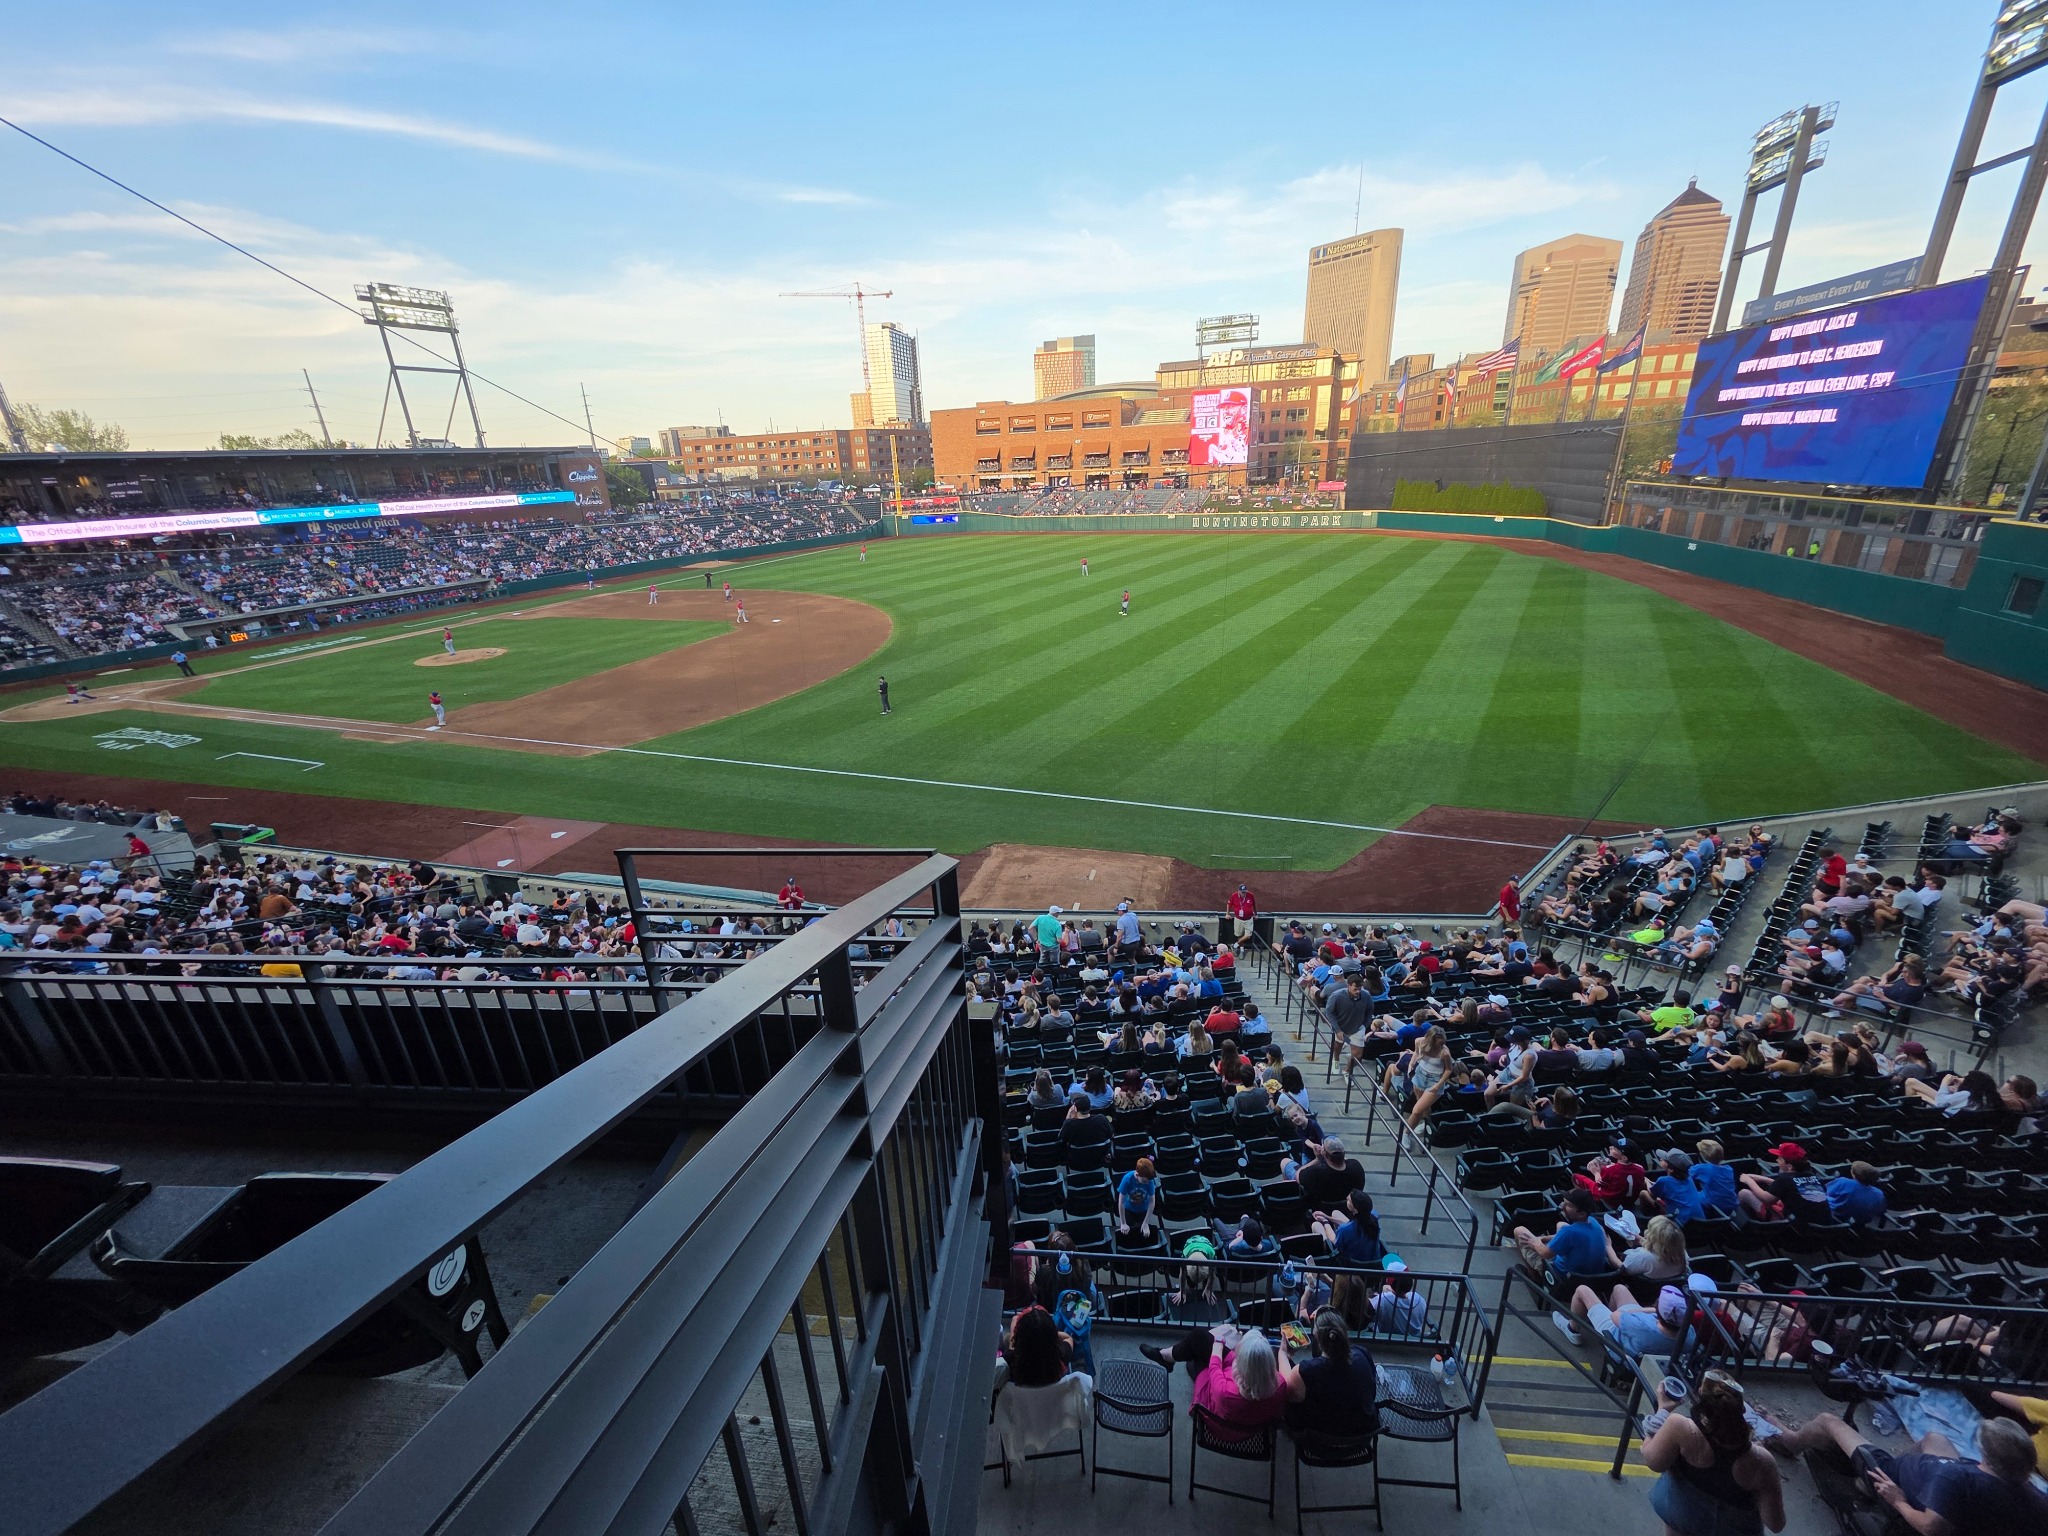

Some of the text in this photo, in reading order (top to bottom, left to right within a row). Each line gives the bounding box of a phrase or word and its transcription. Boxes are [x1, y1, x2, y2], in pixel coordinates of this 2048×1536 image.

[1327, 238, 1368, 255] Nationwide
[1795, 291, 1829, 307] RESIDENT
[1827, 284, 1853, 298] EVERY
[1853, 279, 1871, 292] DAY
[1769, 326, 1793, 342] HAPPY
[1791, 319, 1827, 337] BIRTHDAY
[1825, 314, 1848, 331] JACK
[1207, 350, 1243, 368] AEP
[1243, 352, 1274, 361] Columbia
[1299, 348, 1317, 357] Ohio
[1737, 358, 1760, 374] HAPPY
[1767, 353, 1801, 370] BIRTHDAY
[1799, 351, 1811, 365] TO
[1834, 340, 1884, 360] HENDERSON
[1718, 388, 1738, 402] HAPPY
[1736, 385, 1766, 400] BIRTHDAY
[1765, 383, 1776, 397] TO
[1774, 382, 1789, 396] THE
[1741, 413, 1763, 426] HAPPY
[568, 471, 598, 482] Clippers
[24, 515, 254, 538] The Official Health Insurer of the Columbus Clippers
[326, 516, 400, 533] Speed of pitch
[1192, 515, 1341, 528] HUNTINGTON PARK
[1625, 1174, 1634, 1197] 1
